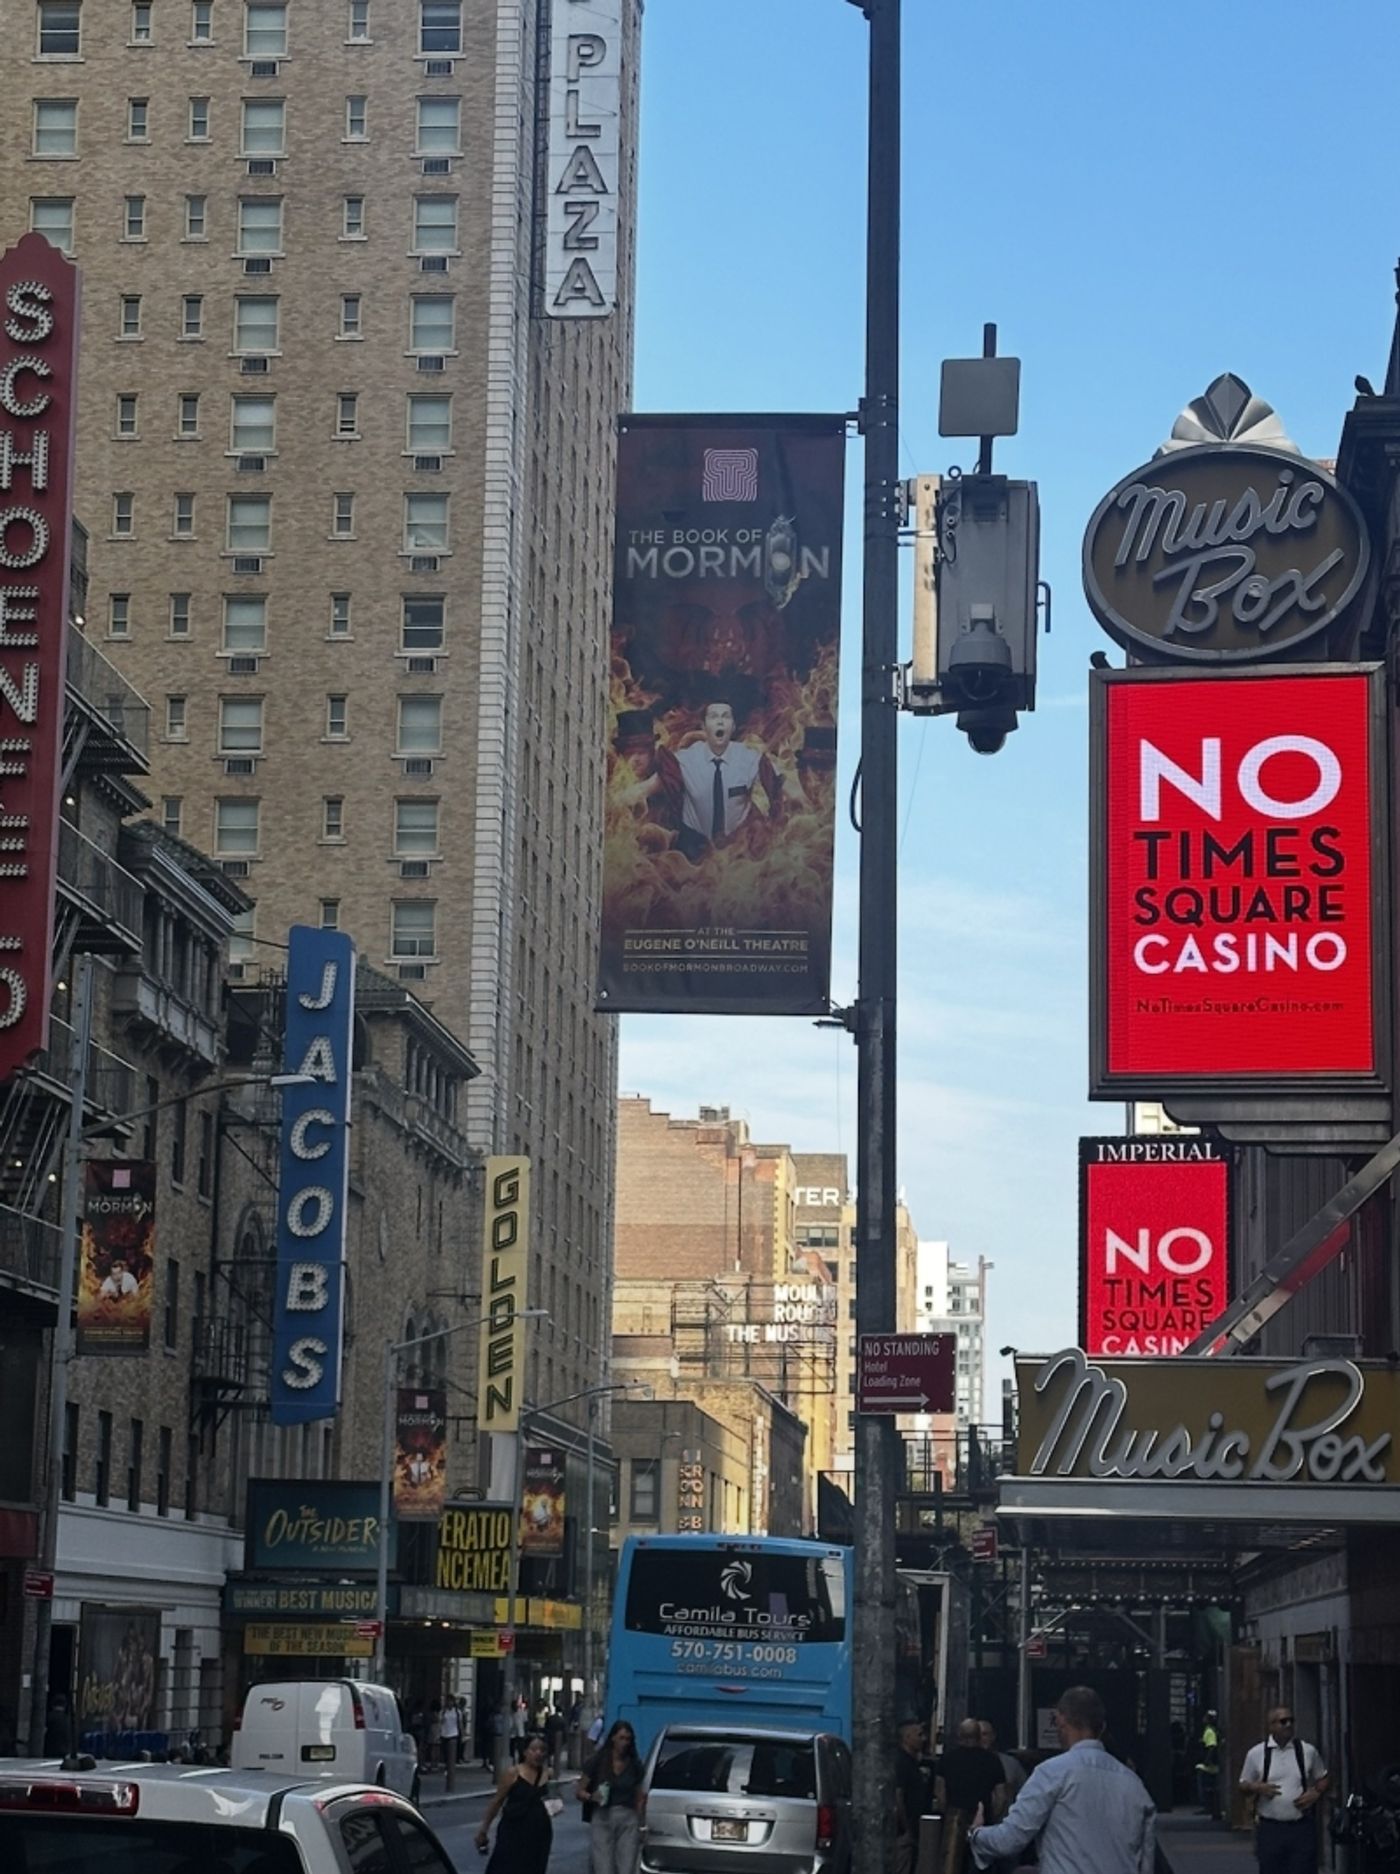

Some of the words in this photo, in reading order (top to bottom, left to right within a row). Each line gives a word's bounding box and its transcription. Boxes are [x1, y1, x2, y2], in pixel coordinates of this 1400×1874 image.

[553, 33, 608, 307] PLAZA
[1113, 469, 1325, 567] Music
[629, 530, 664, 544] THE
[673, 529, 729, 544] BOOK
[736, 529, 763, 544] OF
[1152, 544, 1345, 636] Box
[1140, 735, 1342, 822] NO
[1133, 826, 1345, 880] TIMES
[1134, 884, 1345, 927] SQUARE
[624, 939, 681, 950] EUGENE
[744, 940, 808, 951] THEATRE
[714, 928, 735, 936] THE
[1133, 931, 1347, 974] CASINO
[1097, 1143, 1221, 1162] IMPERIAL
[282, 961, 338, 1389] JACOBS
[1105, 1227, 1213, 1275] NO
[486, 1167, 520, 1421] GOLDEN
[1103, 1278, 1214, 1308] TIMES
[728, 1324, 761, 1343] THE
[1102, 1309, 1213, 1332] SQUARE
[864, 1342, 880, 1356] NO
[883, 1341, 940, 1356] STANDING
[1101, 1336, 1190, 1355] CASIN
[864, 1361, 888, 1373] Hotel
[863, 1376, 897, 1389] Loading
[900, 1376, 921, 1387] Zone
[1030, 1348, 1250, 1479] Music
[1247, 1357, 1392, 1480] Box
[265, 1509, 380, 1548] OUTSIDER
[439, 1510, 511, 1550] ERATIO
[437, 1551, 512, 1591] NCEMEA
[279, 1591, 318, 1609] BEST
[321, 1591, 379, 1610] MUSICA
[659, 1603, 736, 1623] Camila
[744, 1608, 812, 1627] Tours
[664, 1625, 735, 1638] AFFORDABLE
[737, 1630, 759, 1640] BUS
[761, 1631, 806, 1642] SERVICE
[671, 1641, 797, 1664] 570-751-0008
[677, 1662, 782, 1678] camilabus.com
